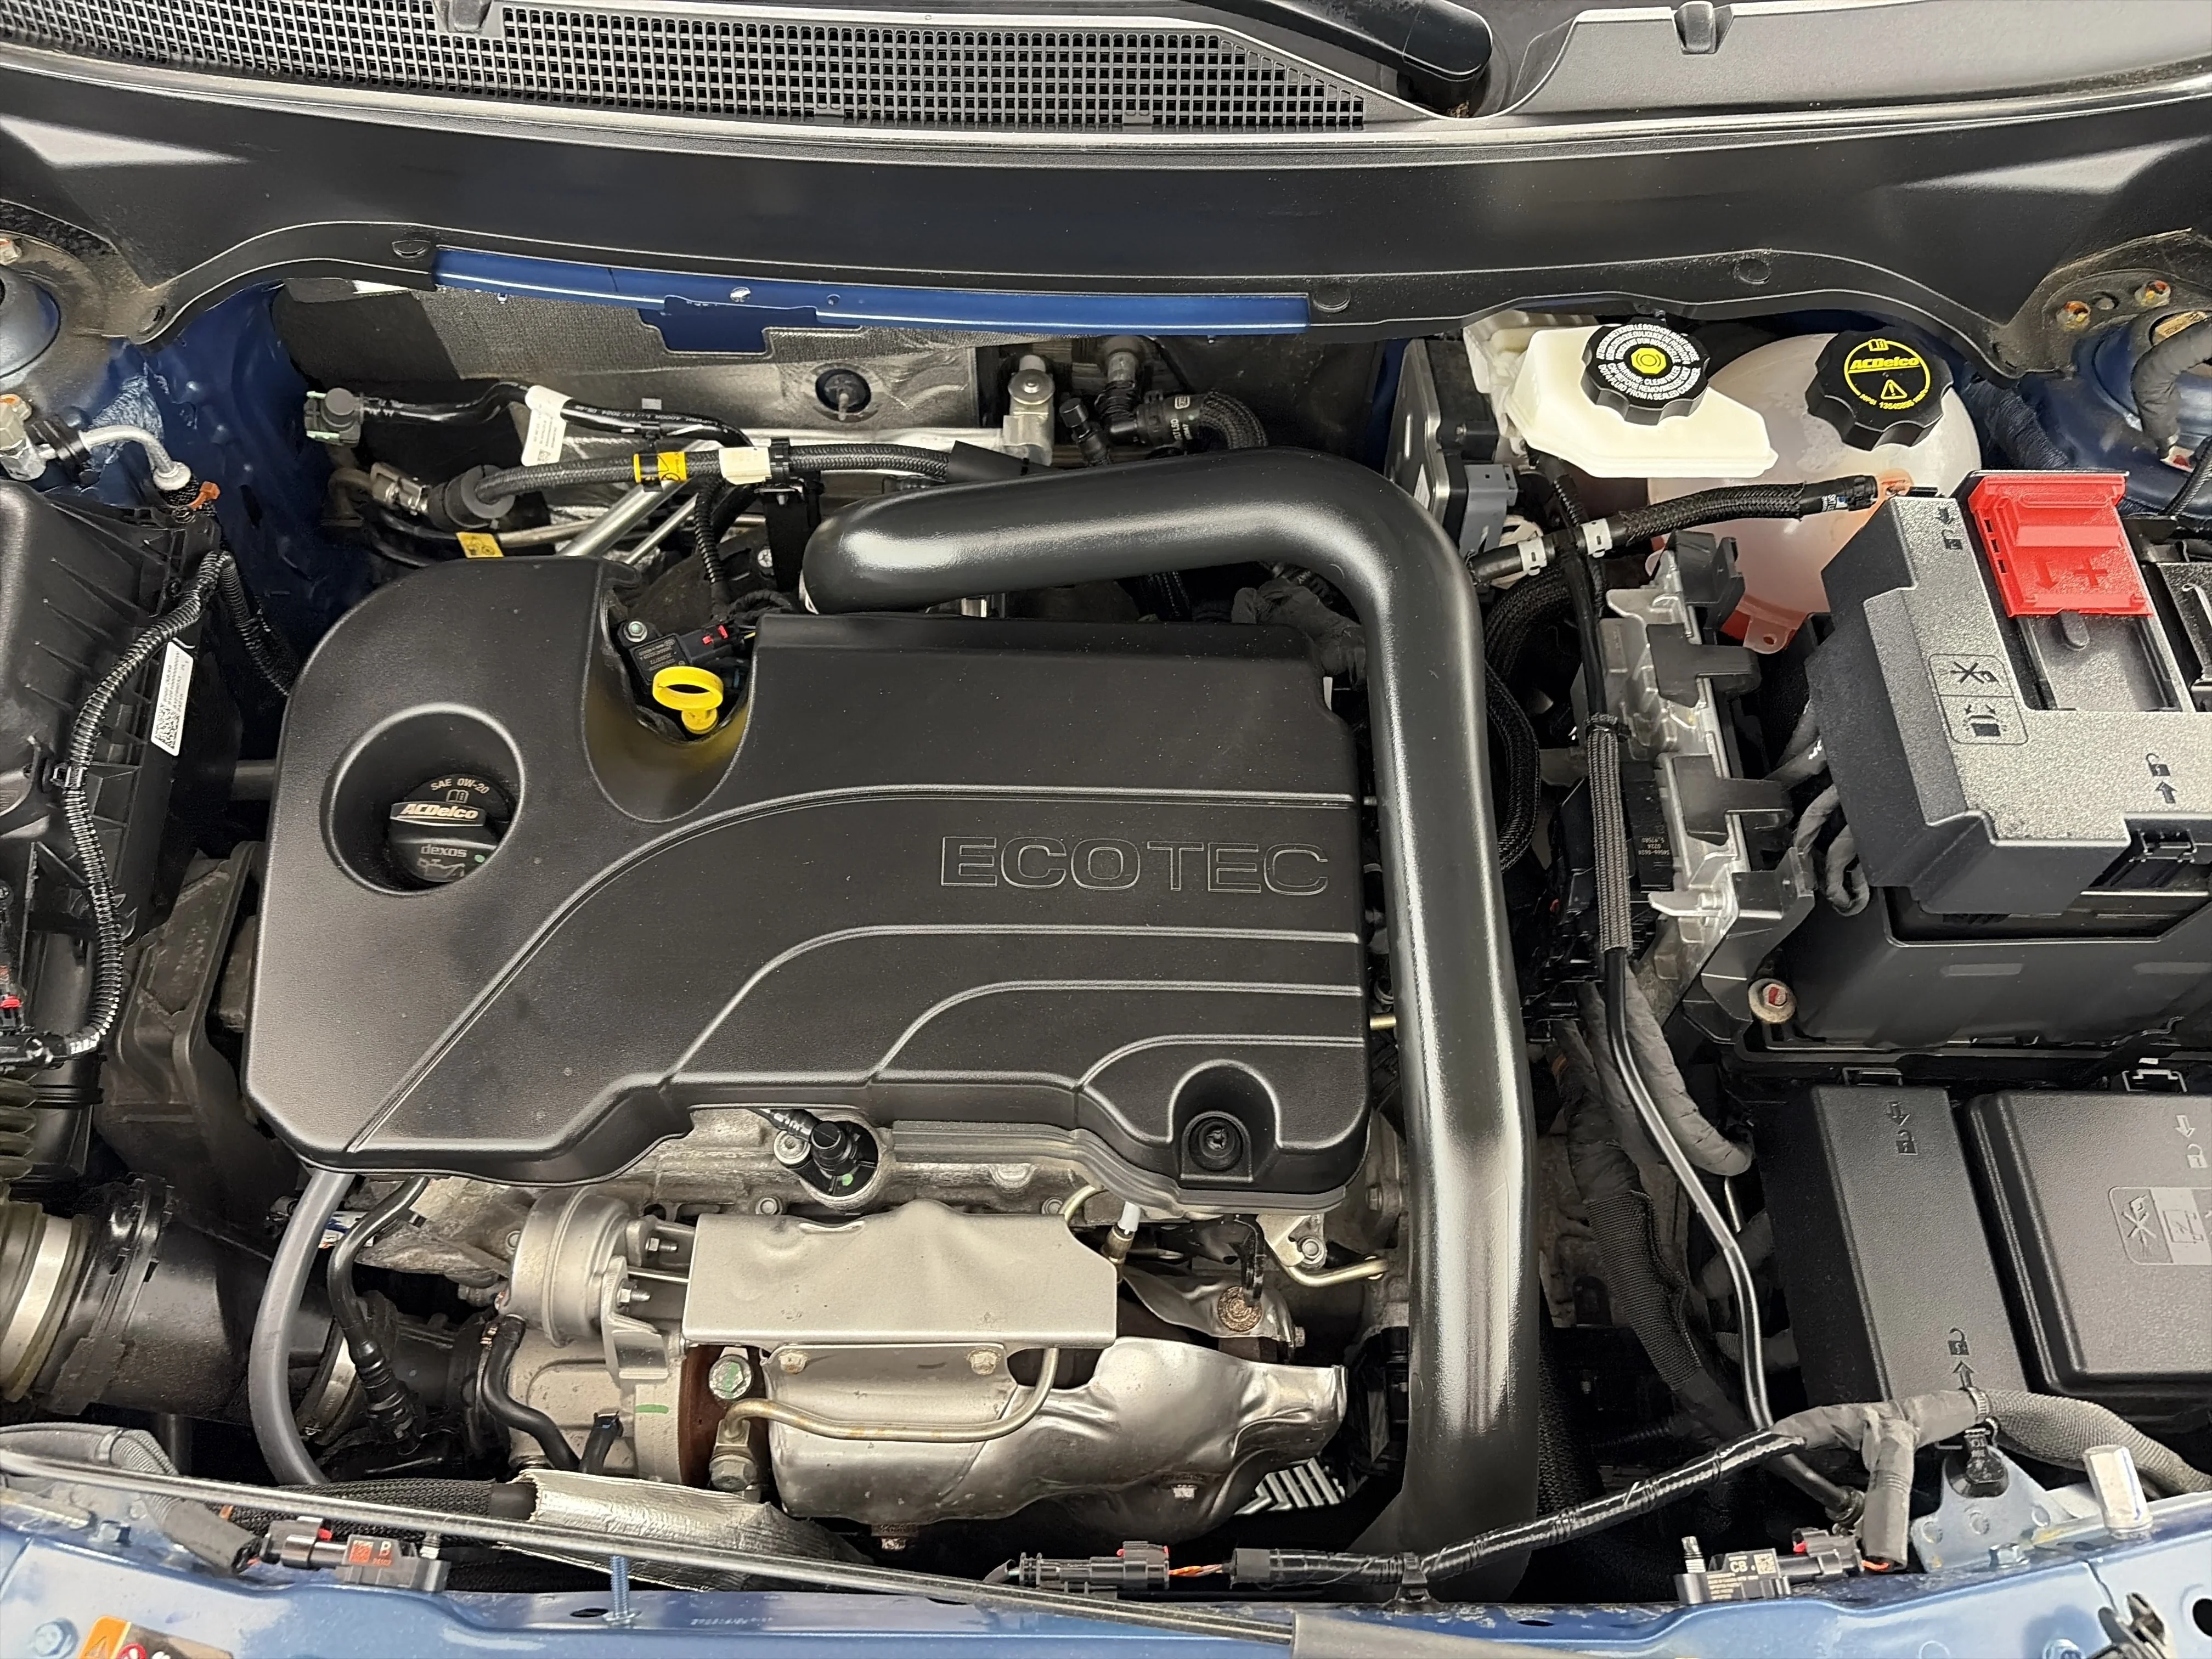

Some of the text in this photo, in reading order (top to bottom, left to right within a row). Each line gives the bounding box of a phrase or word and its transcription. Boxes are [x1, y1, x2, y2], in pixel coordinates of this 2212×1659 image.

[1849, 357, 1920, 370] ACDelco
[1607, 363, 1619, 374] CAP
[1615, 372, 1639, 390] BEFORE
[1610, 377, 1628, 391] FLUID
[1626, 387, 1646, 400] FROM
[431, 778, 490, 794] SAE 0W-20
[400, 804, 479, 819] ACDelco
[420, 844, 468, 857] dexos
[940, 836, 1329, 896] ECOTEC
[1730, 1561, 1748, 1573] CB
